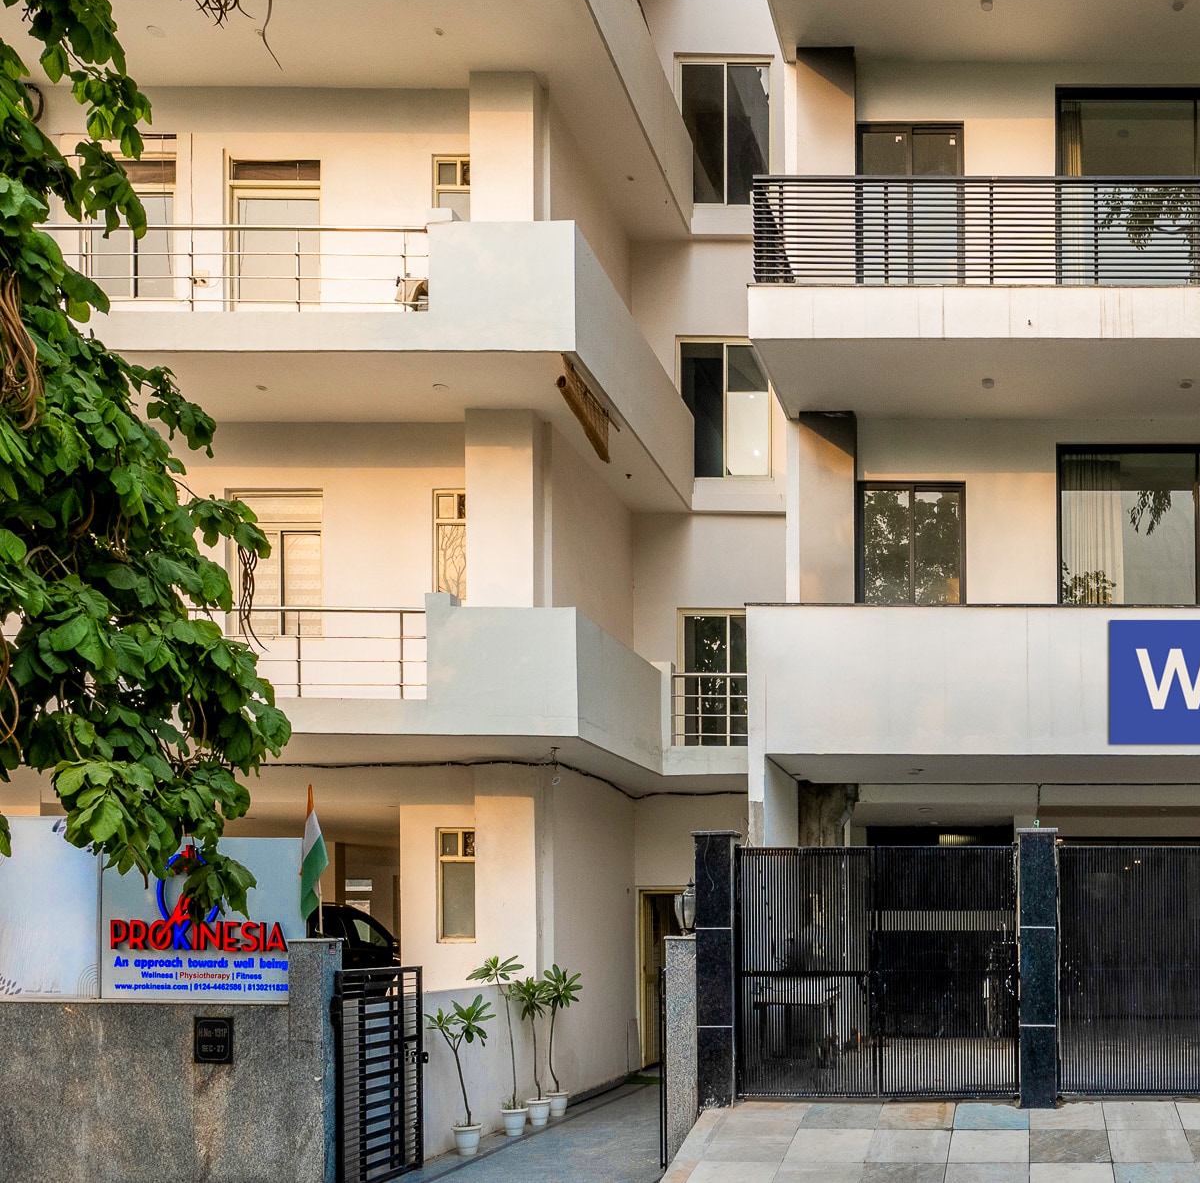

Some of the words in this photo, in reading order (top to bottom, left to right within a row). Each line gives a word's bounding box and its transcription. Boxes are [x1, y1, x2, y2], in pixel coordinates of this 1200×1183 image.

[110, 919, 288, 952] PROKINESIA
[114, 955, 129, 967] An
[134, 956, 183, 969] approach
[188, 956, 229, 968] towards
[233, 957, 254, 968] well
[259, 957, 288, 971] being
[141, 971, 173, 979] Wellness
[180, 971, 230, 980] Physiotherapy
[236, 972, 262, 980] Fitness
[114, 983, 188, 991] www.prokinesia.com
